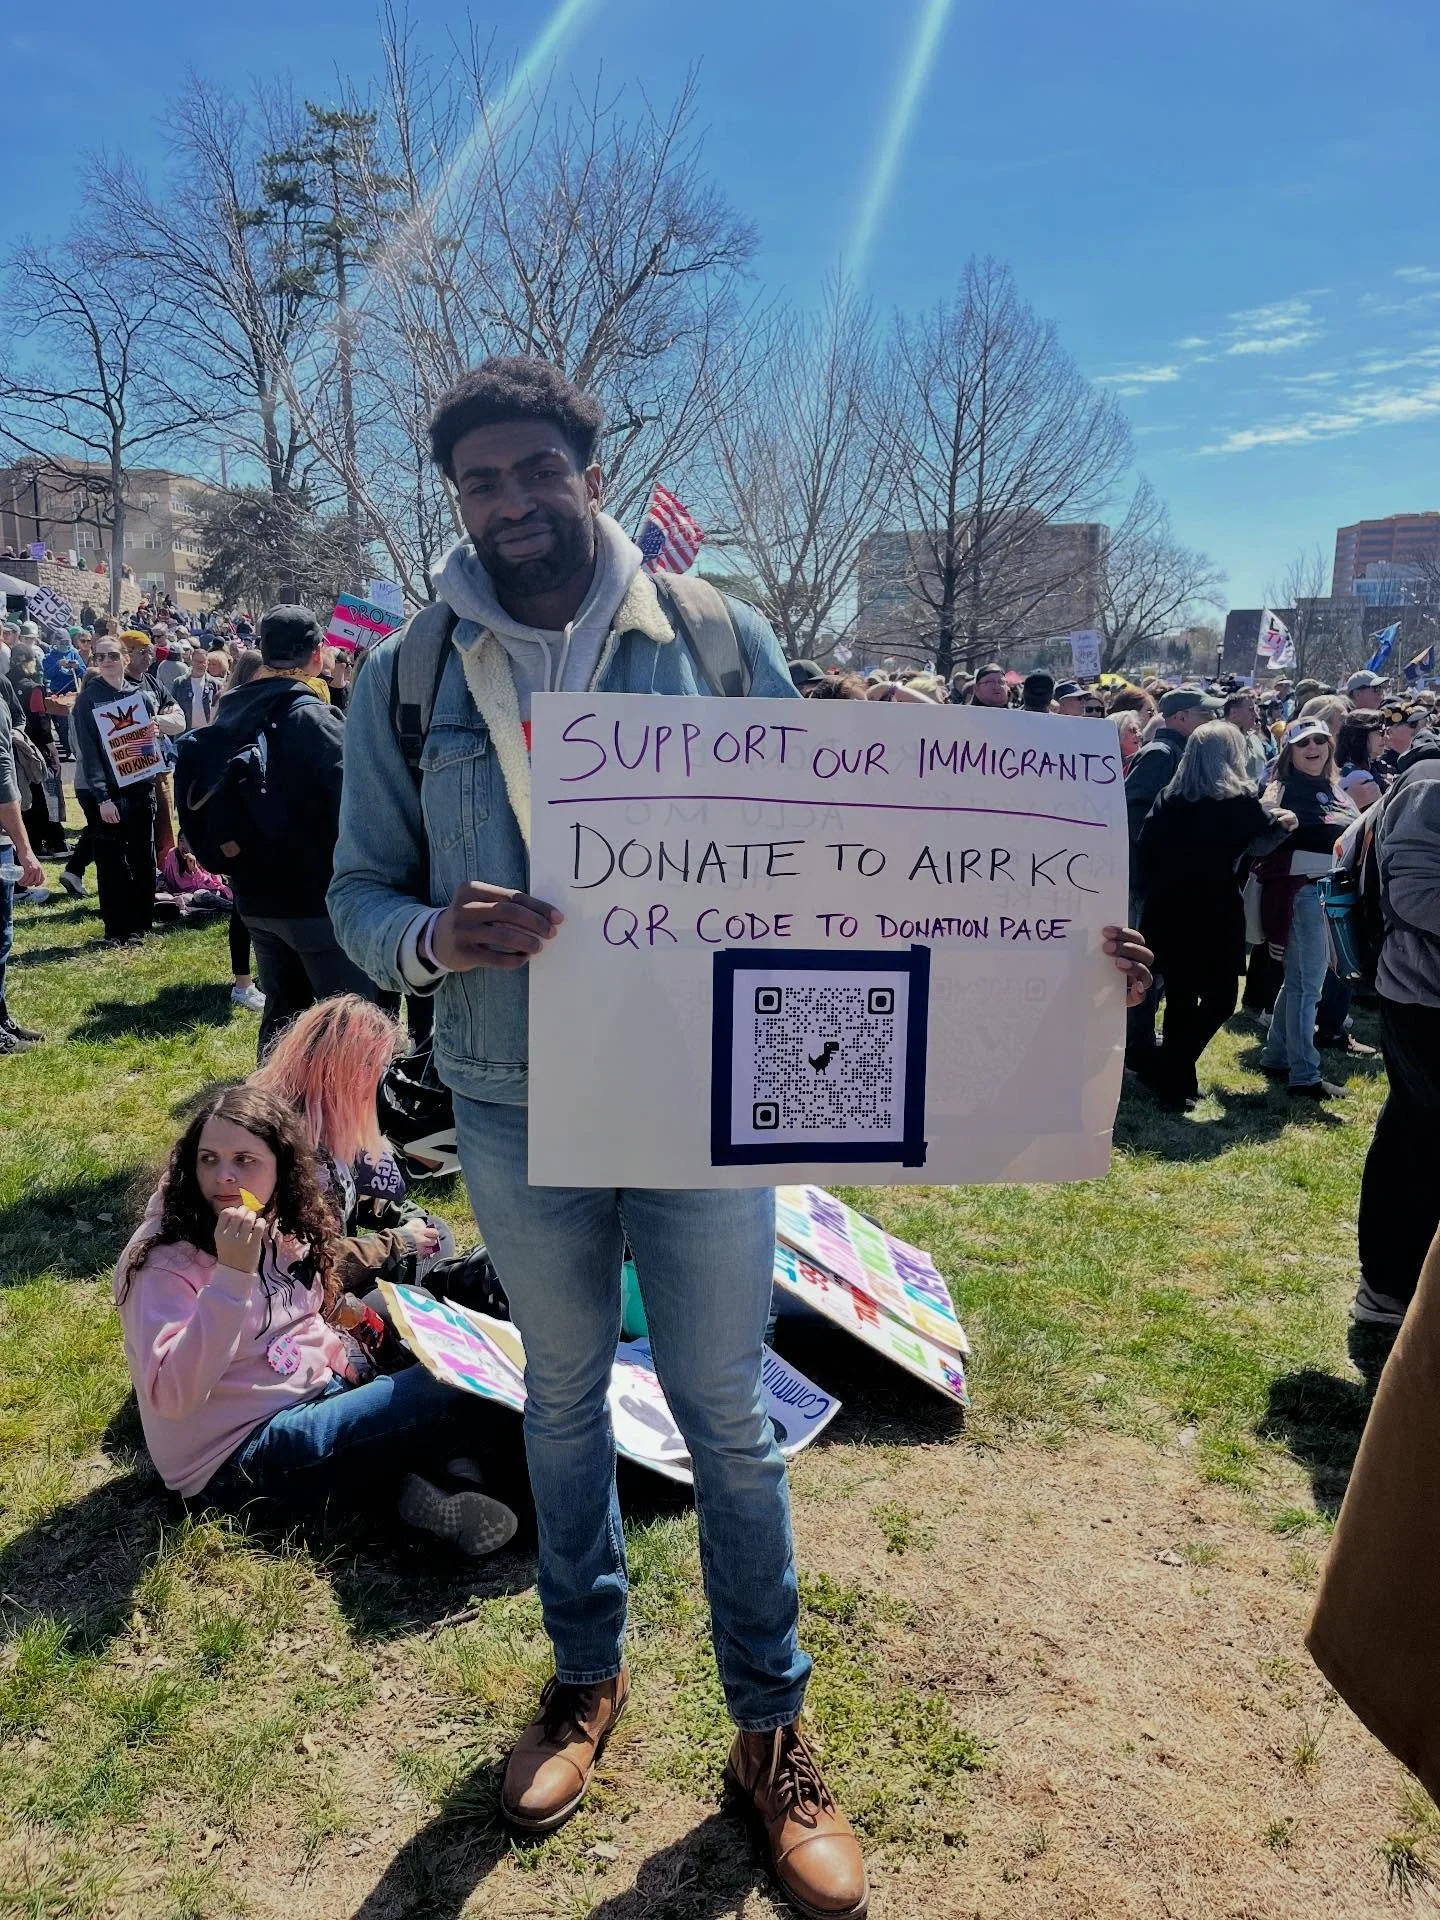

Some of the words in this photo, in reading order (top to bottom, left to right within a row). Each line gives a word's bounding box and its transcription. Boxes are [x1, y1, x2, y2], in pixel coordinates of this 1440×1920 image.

[28, 586, 53, 612] END
[35, 593, 65, 622] ICE
[46, 602, 73, 631] NOW
[109, 736, 121, 749] NO
[114, 750, 125, 762] NO
[560, 714, 807, 781] SUPPORT
[813, 739, 889, 779] OUR
[919, 738, 1116, 785] IMMIGRANTS
[118, 761, 132, 777] NO
[570, 822, 805, 889] DONATE
[825, 843, 886, 877] TO
[909, 846, 1013, 884] AIRR
[1031, 849, 1099, 893] KC
[603, 905, 678, 949] QR
[697, 909, 792, 942] CODE
[816, 914, 858, 938] TO
[875, 915, 989, 940] DONATION
[1000, 917, 1072, 942] PAGE
